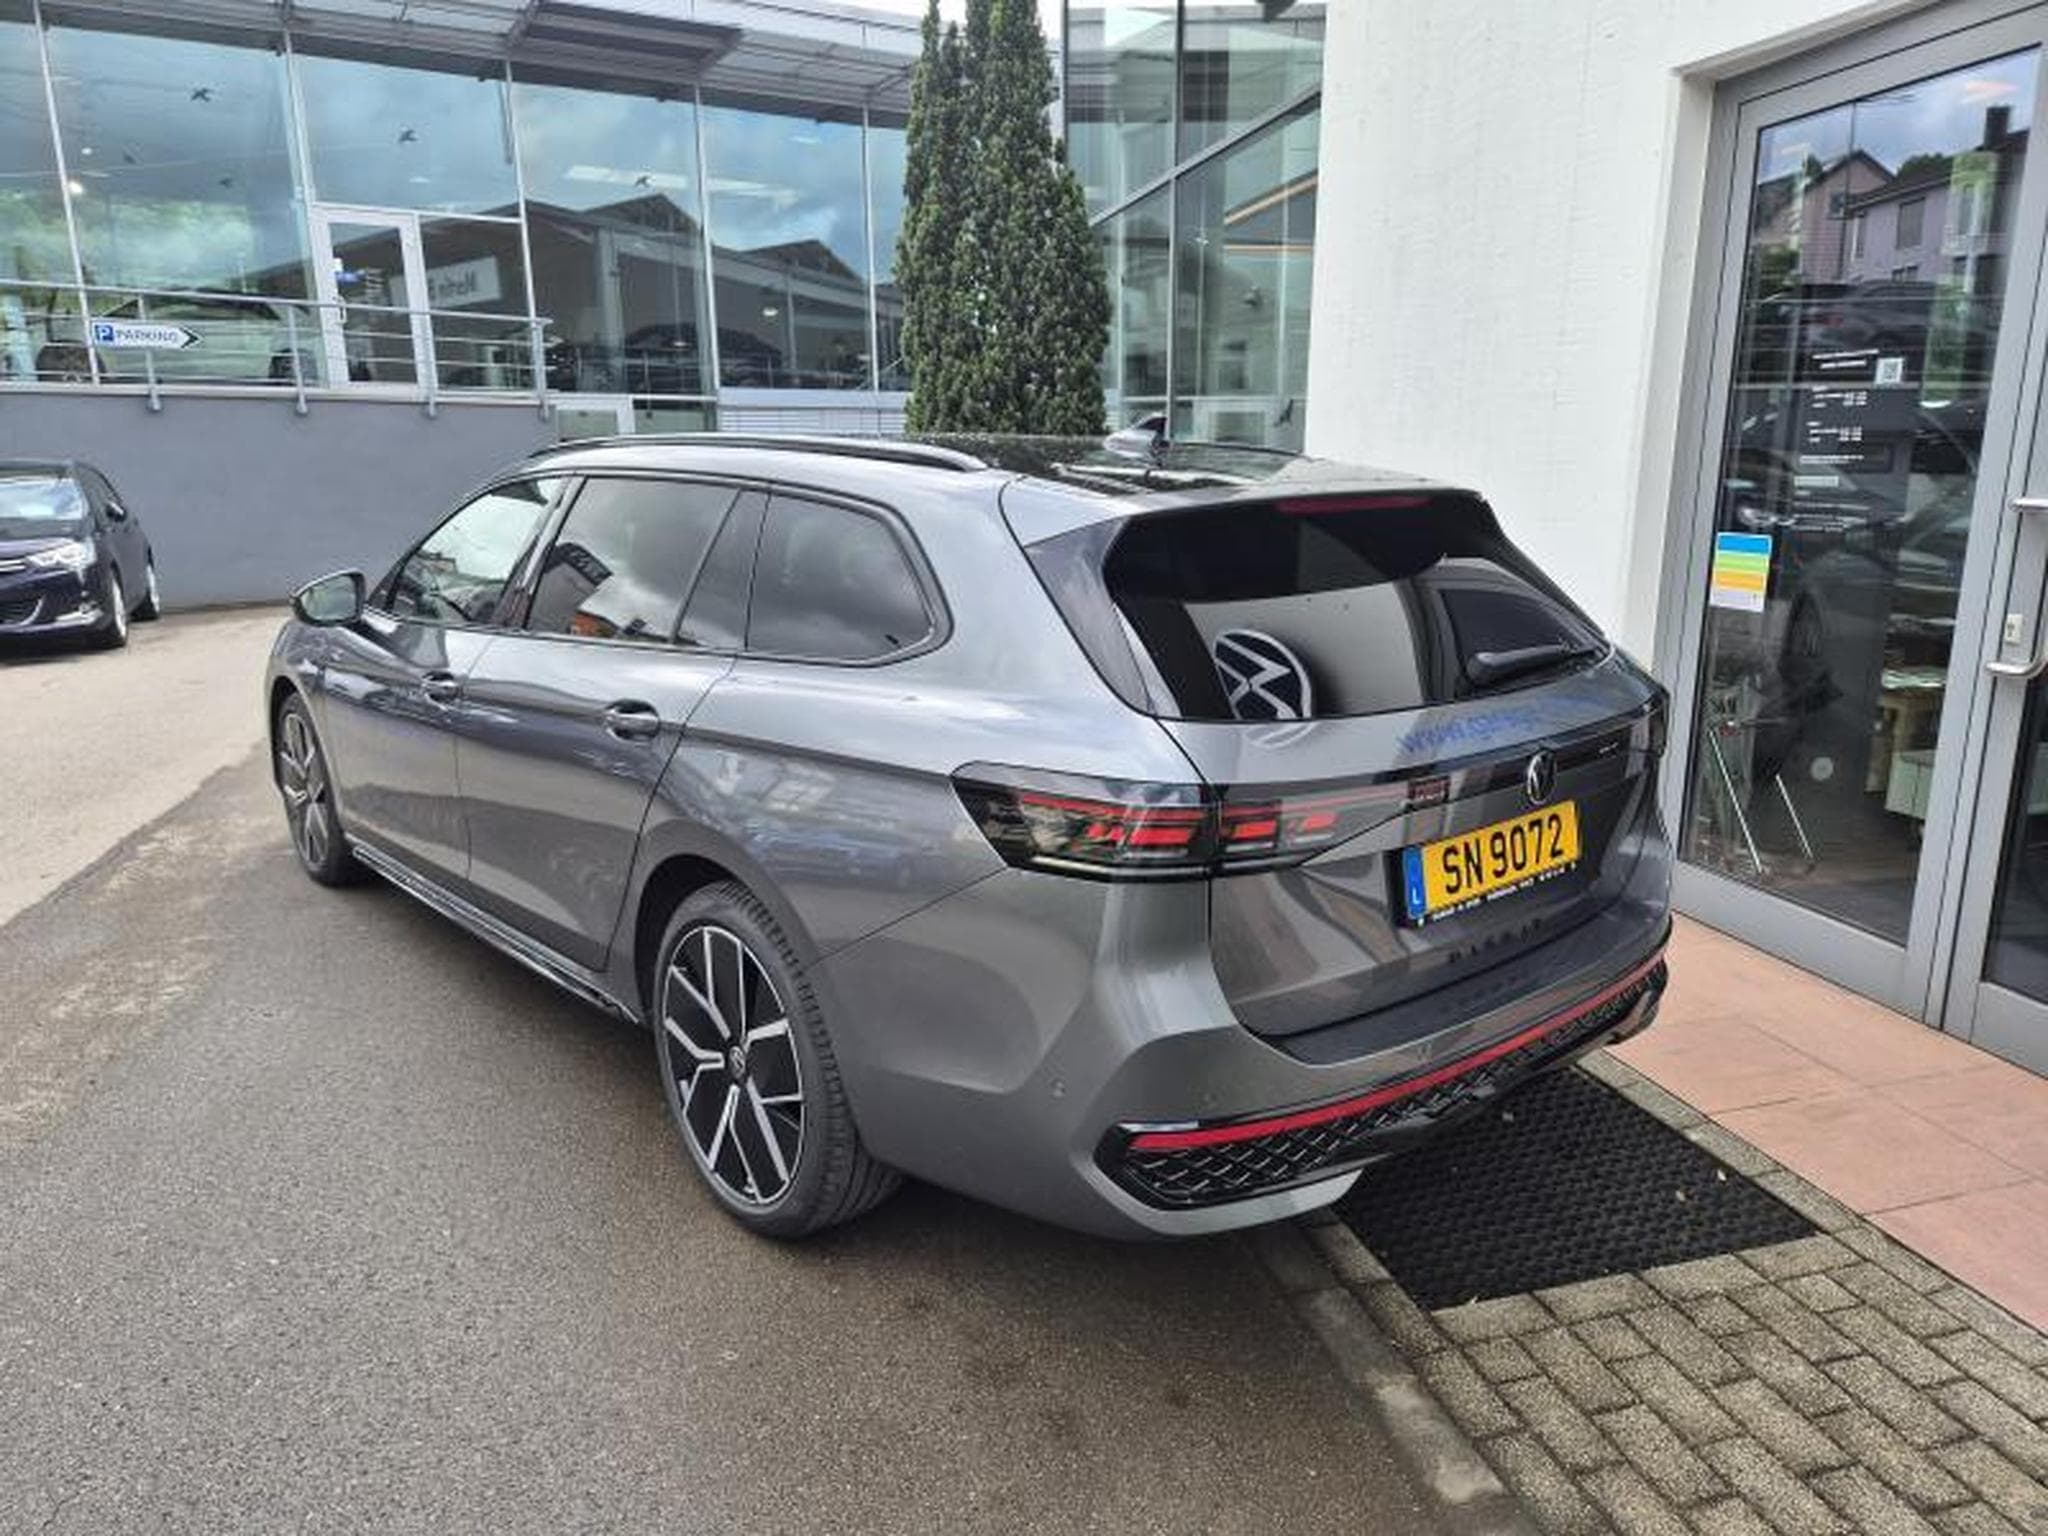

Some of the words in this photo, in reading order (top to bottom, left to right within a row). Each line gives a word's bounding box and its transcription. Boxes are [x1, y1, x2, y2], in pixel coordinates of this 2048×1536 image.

[98, 326, 112, 341] P
[116, 328, 178, 343] PARKING
[1442, 837, 1484, 895] SN
[1490, 813, 1564, 879] 9072
[1412, 886, 1422, 905] L
